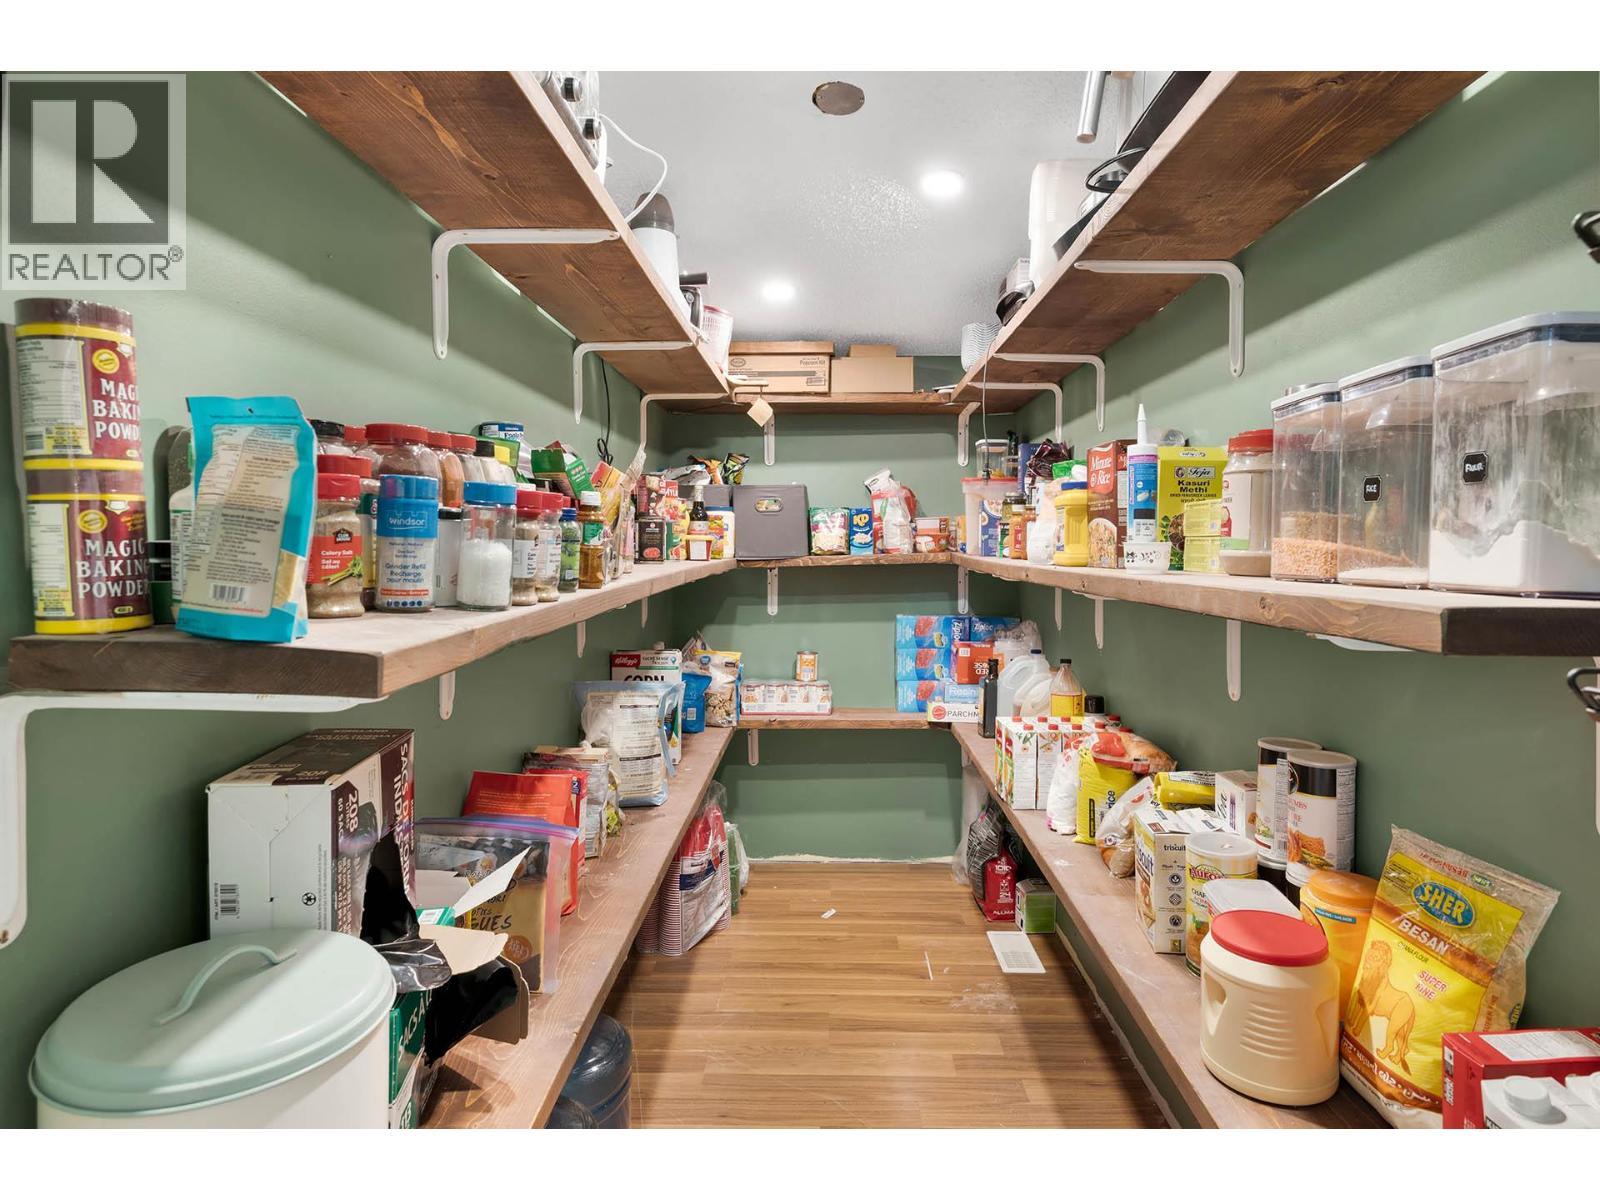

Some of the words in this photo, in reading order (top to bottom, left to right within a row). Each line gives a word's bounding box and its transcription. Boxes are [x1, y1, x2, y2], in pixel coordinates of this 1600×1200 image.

[100, 378, 138, 400] MAG
[94, 421, 141, 440] POWD
[85, 539, 145, 557] MAGIC
[952, 621, 962, 640] Ziplo
[401, 743, 409, 796] SACS
[349, 791, 359, 832] 208
[394, 775, 403, 846] INDUS
[1421, 885, 1465, 923] SHER
[1398, 919, 1449, 955] BESAN
[1416, 983, 1435, 999] FINE
[1420, 971, 1446, 992] SUPER
